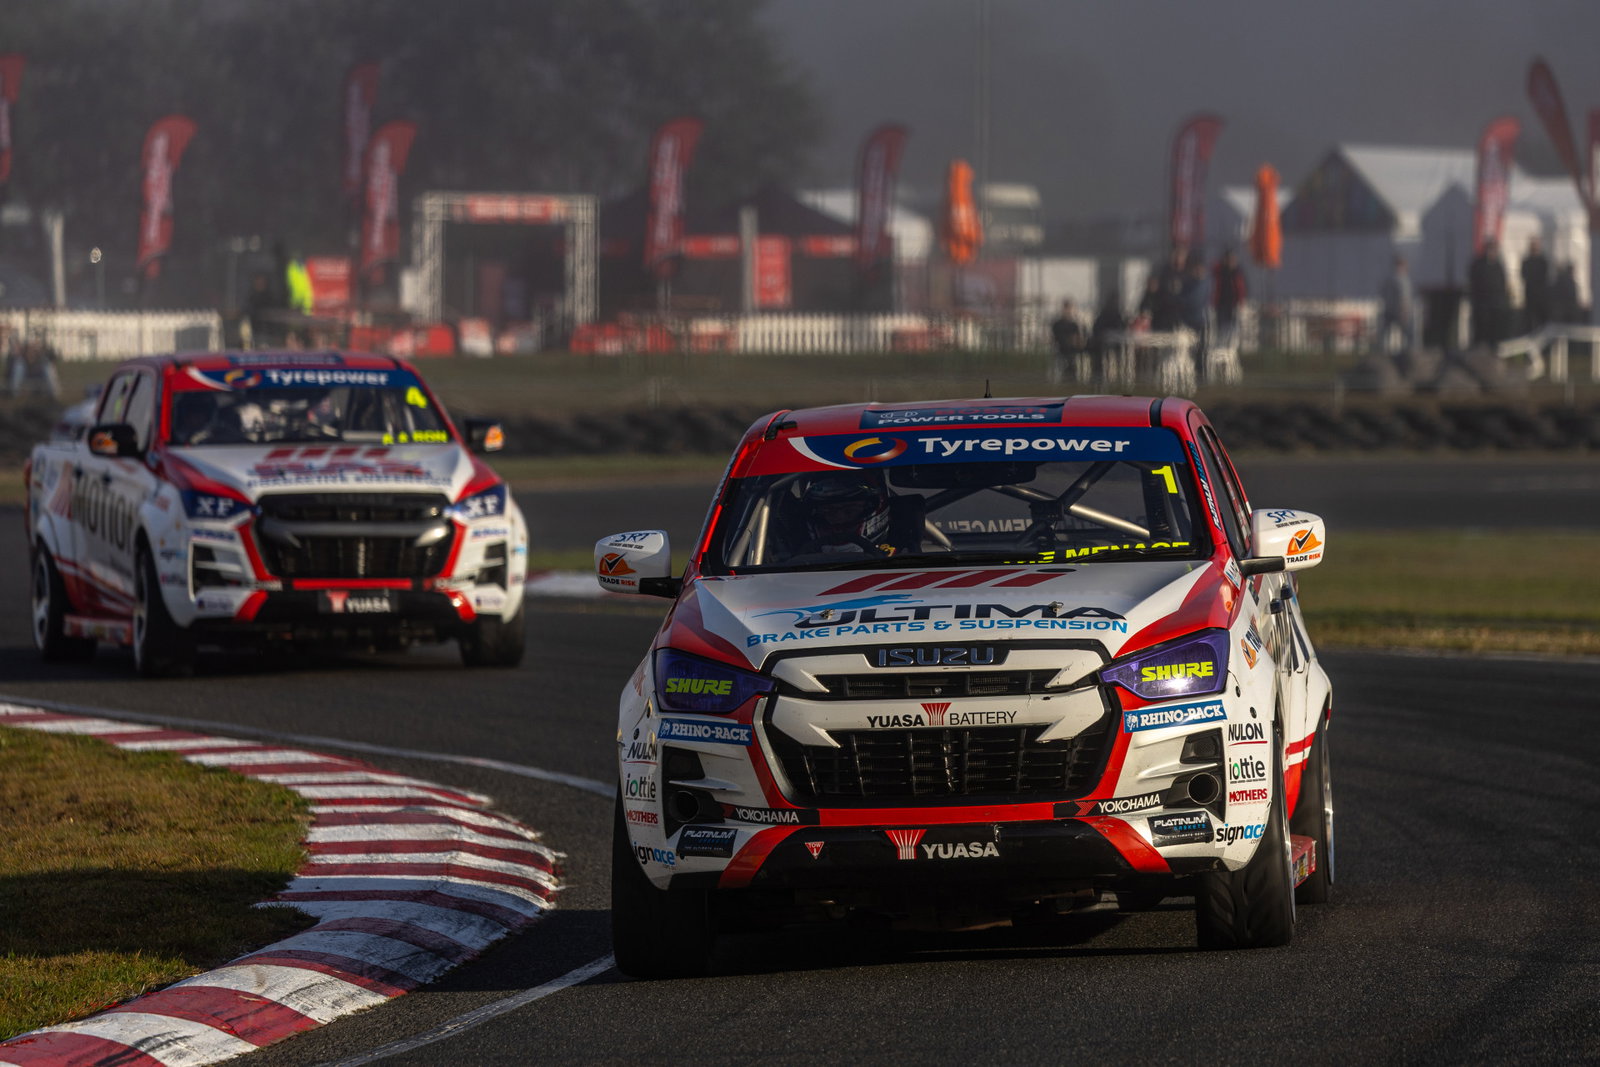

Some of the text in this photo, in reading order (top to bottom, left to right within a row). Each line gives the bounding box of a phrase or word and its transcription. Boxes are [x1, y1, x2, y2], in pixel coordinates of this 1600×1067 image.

[265, 368, 389, 386] Tyrepower
[878, 413, 1045, 425] POWER TOOLS
[918, 437, 1130, 456] Tyrepower
[1151, 465, 1179, 494] 1
[197, 496, 234, 516] XF
[466, 494, 499, 517] XF
[615, 532, 657, 543] SRT
[1287, 555, 1308, 563] TRADE
[600, 576, 619, 584] TRADE
[346, 597, 391, 613] YUASA
[794, 604, 1126, 628] ULTIMA
[747, 619, 1128, 647] BRAKE PARTS & SUSPENSION
[878, 647, 994, 666] ISUZU
[1141, 661, 1214, 682] SHURE
[665, 678, 733, 696] SHURE
[867, 711, 1017, 728] YUASA BATTERY
[1140, 704, 1224, 726] RHINO-RACK
[670, 722, 750, 742] RHINO-RACK
[1228, 722, 1264, 742] NULON
[627, 741, 658, 761] NULON
[1228, 755, 1266, 780] iottie
[625, 773, 656, 798] iottie
[1229, 788, 1268, 802] MOTHERS
[1098, 793, 1160, 813] YOKOHAMA
[627, 809, 658, 824] MOTHERS
[736, 808, 799, 823] YOKOHAMA
[1154, 818, 1206, 828] PLATINUM
[684, 830, 733, 839] PLATINUM
[921, 842, 1000, 860] YUASA
